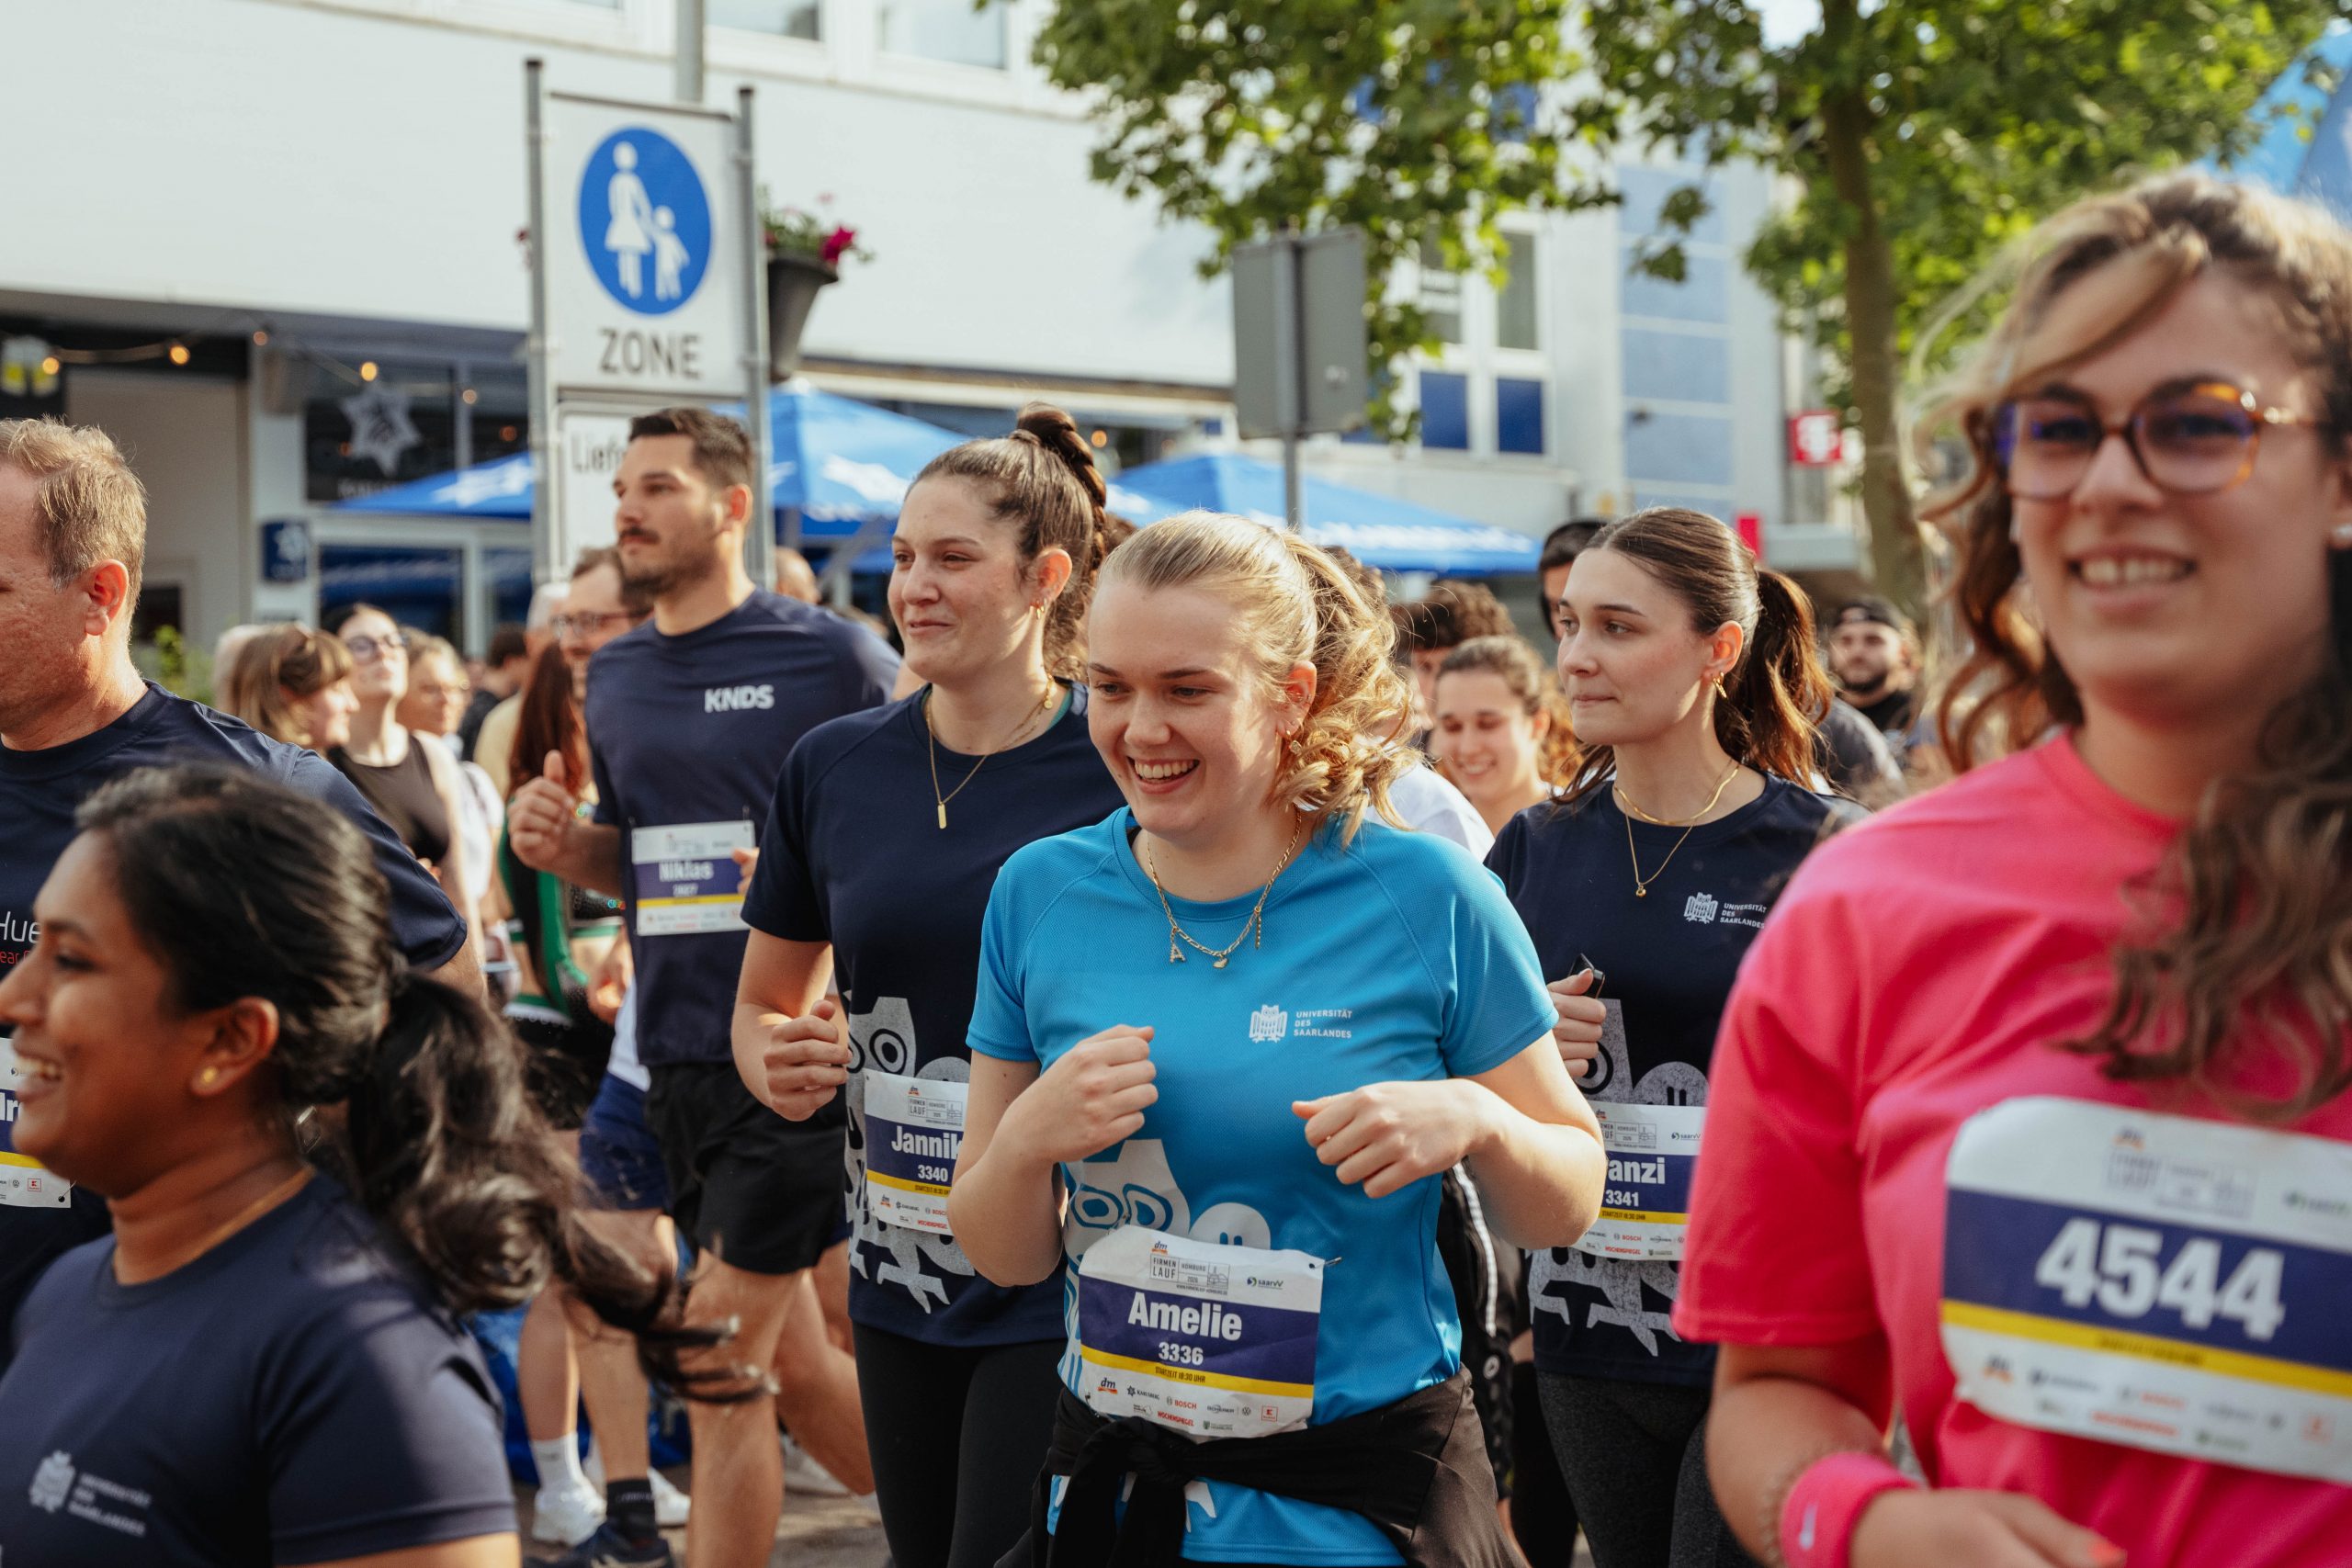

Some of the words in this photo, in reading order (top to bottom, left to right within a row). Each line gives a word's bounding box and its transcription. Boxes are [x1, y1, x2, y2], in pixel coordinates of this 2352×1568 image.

[598, 328, 703, 380] ZONE
[705, 685, 775, 712] KNDS
[1724, 902, 1767, 913] UNIVERSITÄT
[1719, 917, 1765, 929] SAARLANDES
[1295, 1009, 1352, 1019] UNIVERSITÄT
[1293, 1029, 1351, 1039] SAARLANDES
[918, 1164, 948, 1182] 3340
[1608, 1156, 1665, 1184] anzi
[1605, 1190, 1639, 1206] 3341
[1153, 1258, 1176, 1268] FIRMEN
[1152, 1267, 1176, 1279] LAUF
[2034, 1217, 2286, 1342] 4544
[1128, 1292, 1242, 1341] Amelie
[1159, 1342, 1204, 1366] 3336
[1101, 1377, 1115, 1389] dm
[1193, 1374, 1205, 1383] UHR
[1174, 1399, 1196, 1409] BOSCH
[1158, 1410, 1193, 1426] WOCHENSPIEGEL
